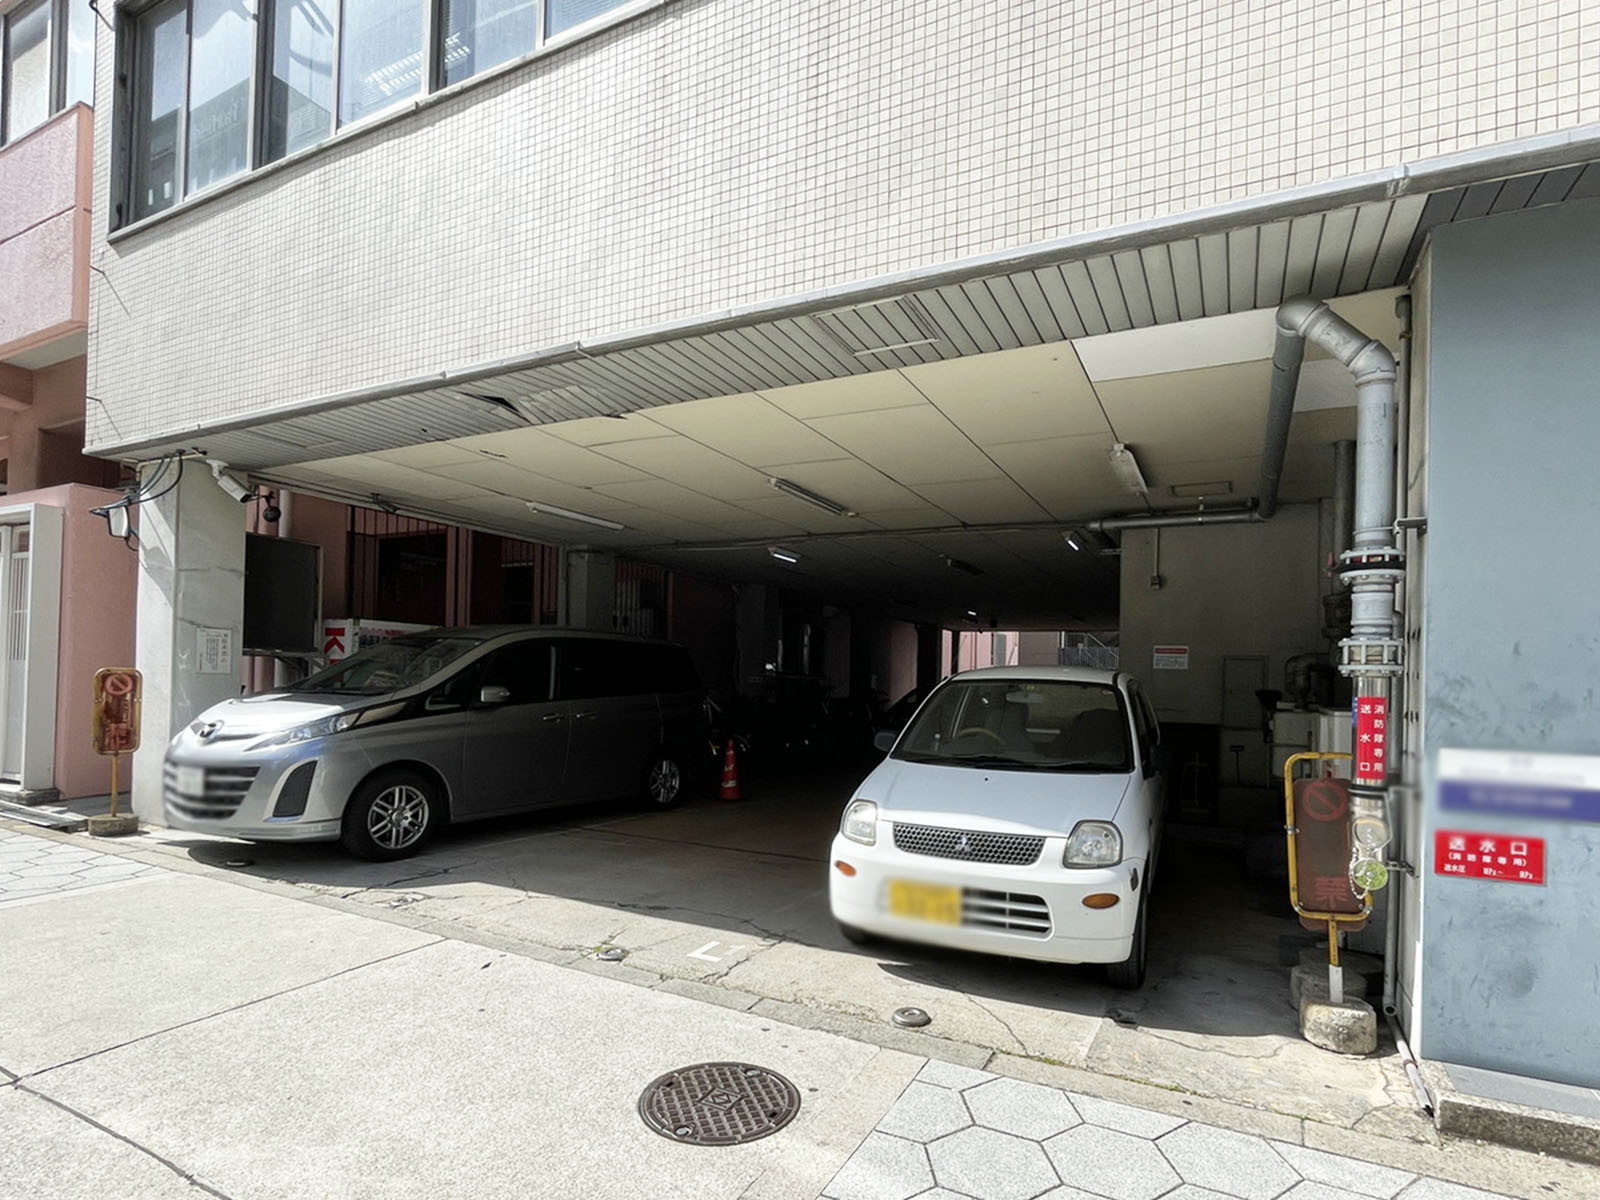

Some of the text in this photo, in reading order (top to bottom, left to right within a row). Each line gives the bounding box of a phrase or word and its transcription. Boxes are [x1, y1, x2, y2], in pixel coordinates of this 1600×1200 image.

[1360, 704, 1372, 771] 送水口
[1373, 704, 1384, 772] 消防隊専用
[1448, 836, 1527, 856] 送水口
